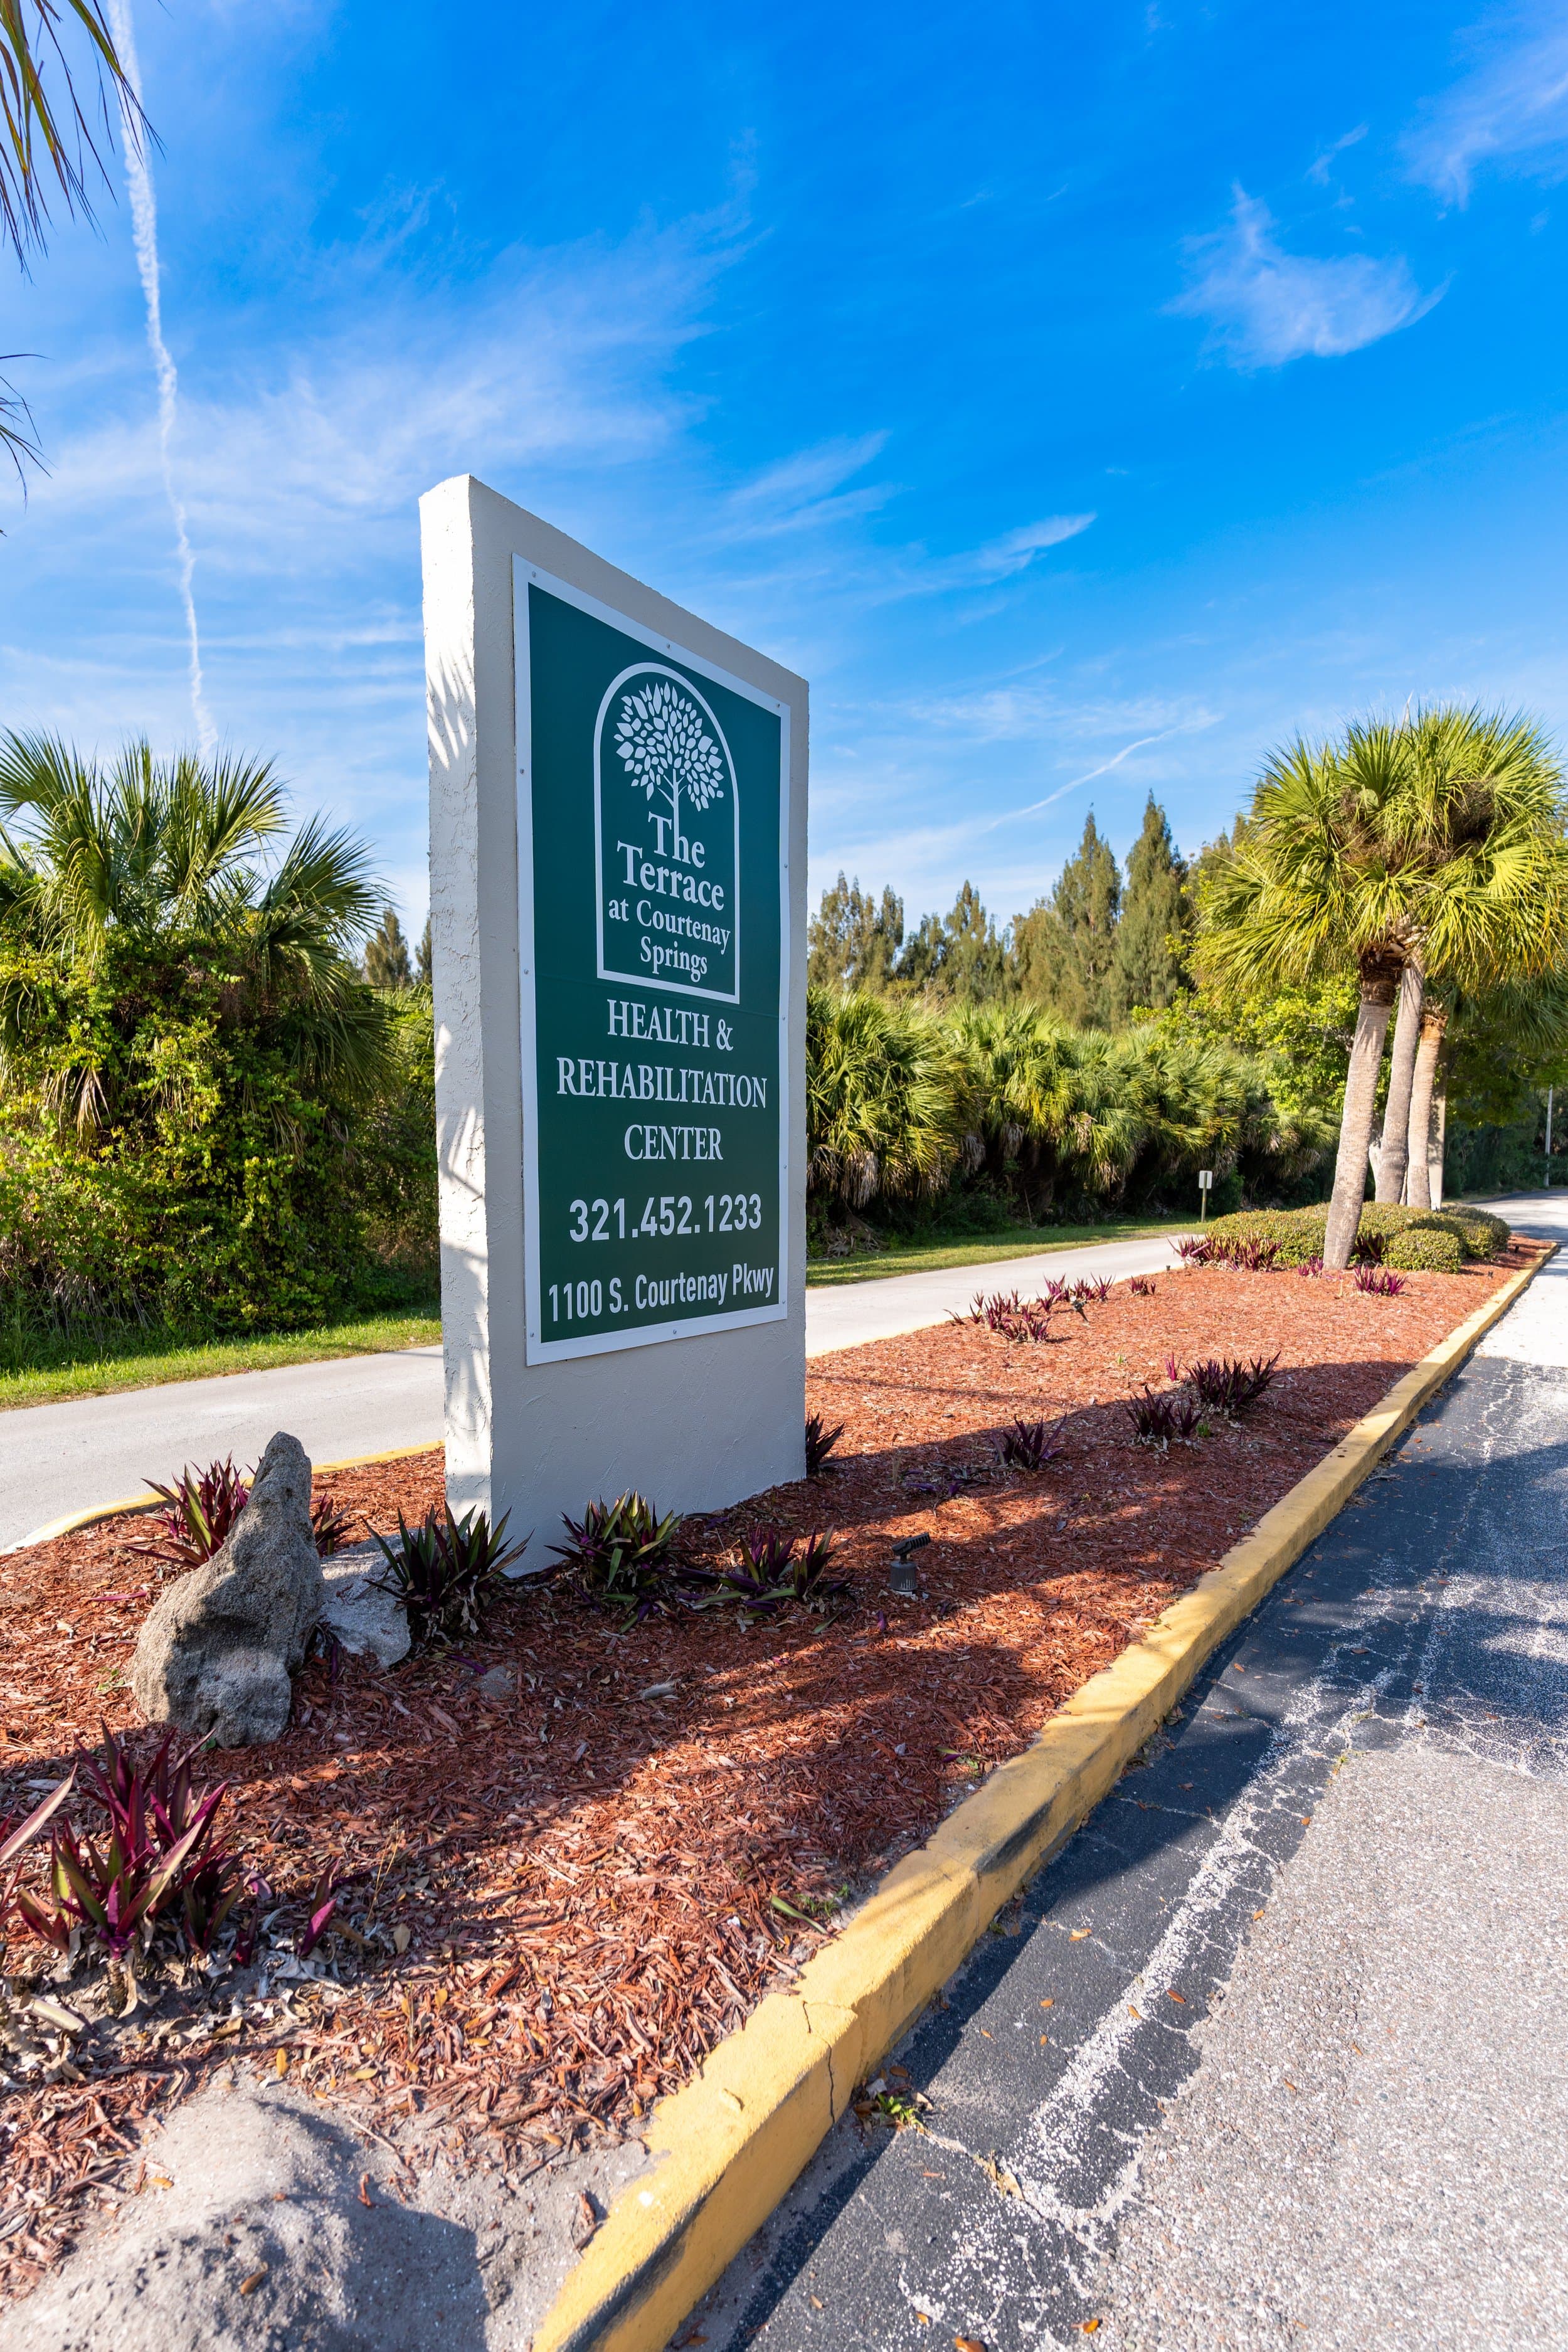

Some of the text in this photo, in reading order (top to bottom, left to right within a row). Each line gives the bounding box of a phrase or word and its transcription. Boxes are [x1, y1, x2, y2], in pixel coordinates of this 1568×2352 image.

[648, 812, 705, 868] The
[617, 840, 724, 911] Terrace
[608, 899, 731, 955] at Courtenay
[640, 936, 707, 982] Springs
[607, 999, 734, 1051] HEALTH &
[556, 1057, 767, 1108] REHABILITATION
[624, 1125, 723, 1160] CENTER
[569, 1194, 761, 1242] 321.452.1233
[549, 1263, 774, 1322] 1100 S. Courtenay Pkwy
